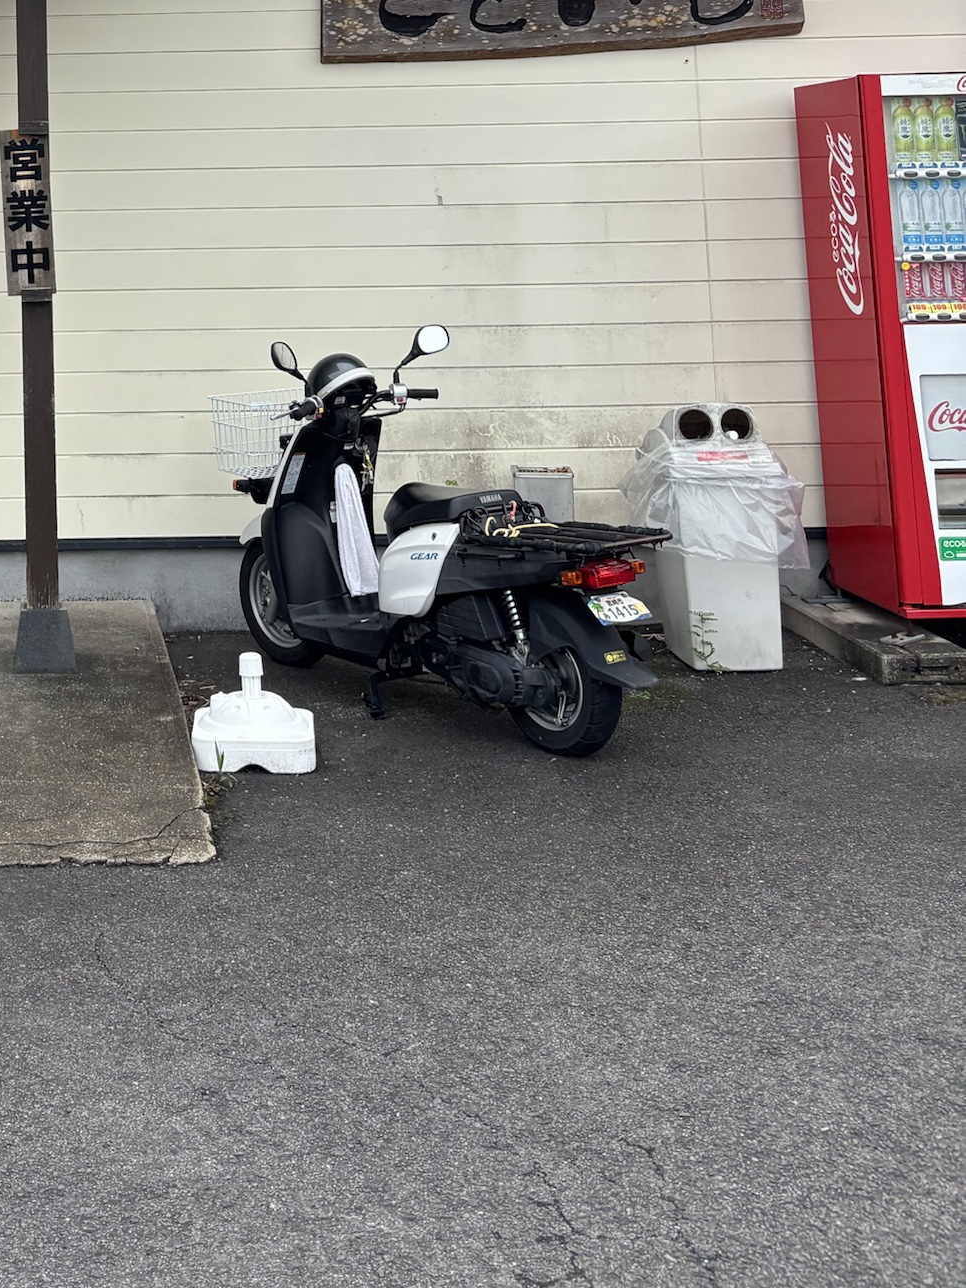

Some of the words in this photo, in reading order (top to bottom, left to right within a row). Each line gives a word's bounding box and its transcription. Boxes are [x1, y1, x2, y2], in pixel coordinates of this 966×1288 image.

[4, 138, 50, 283] 営業中
[825, 122, 865, 316] Coca-Cola
[479, 494, 502, 504] YAMAHA
[608, 604, 639, 620] 1415
